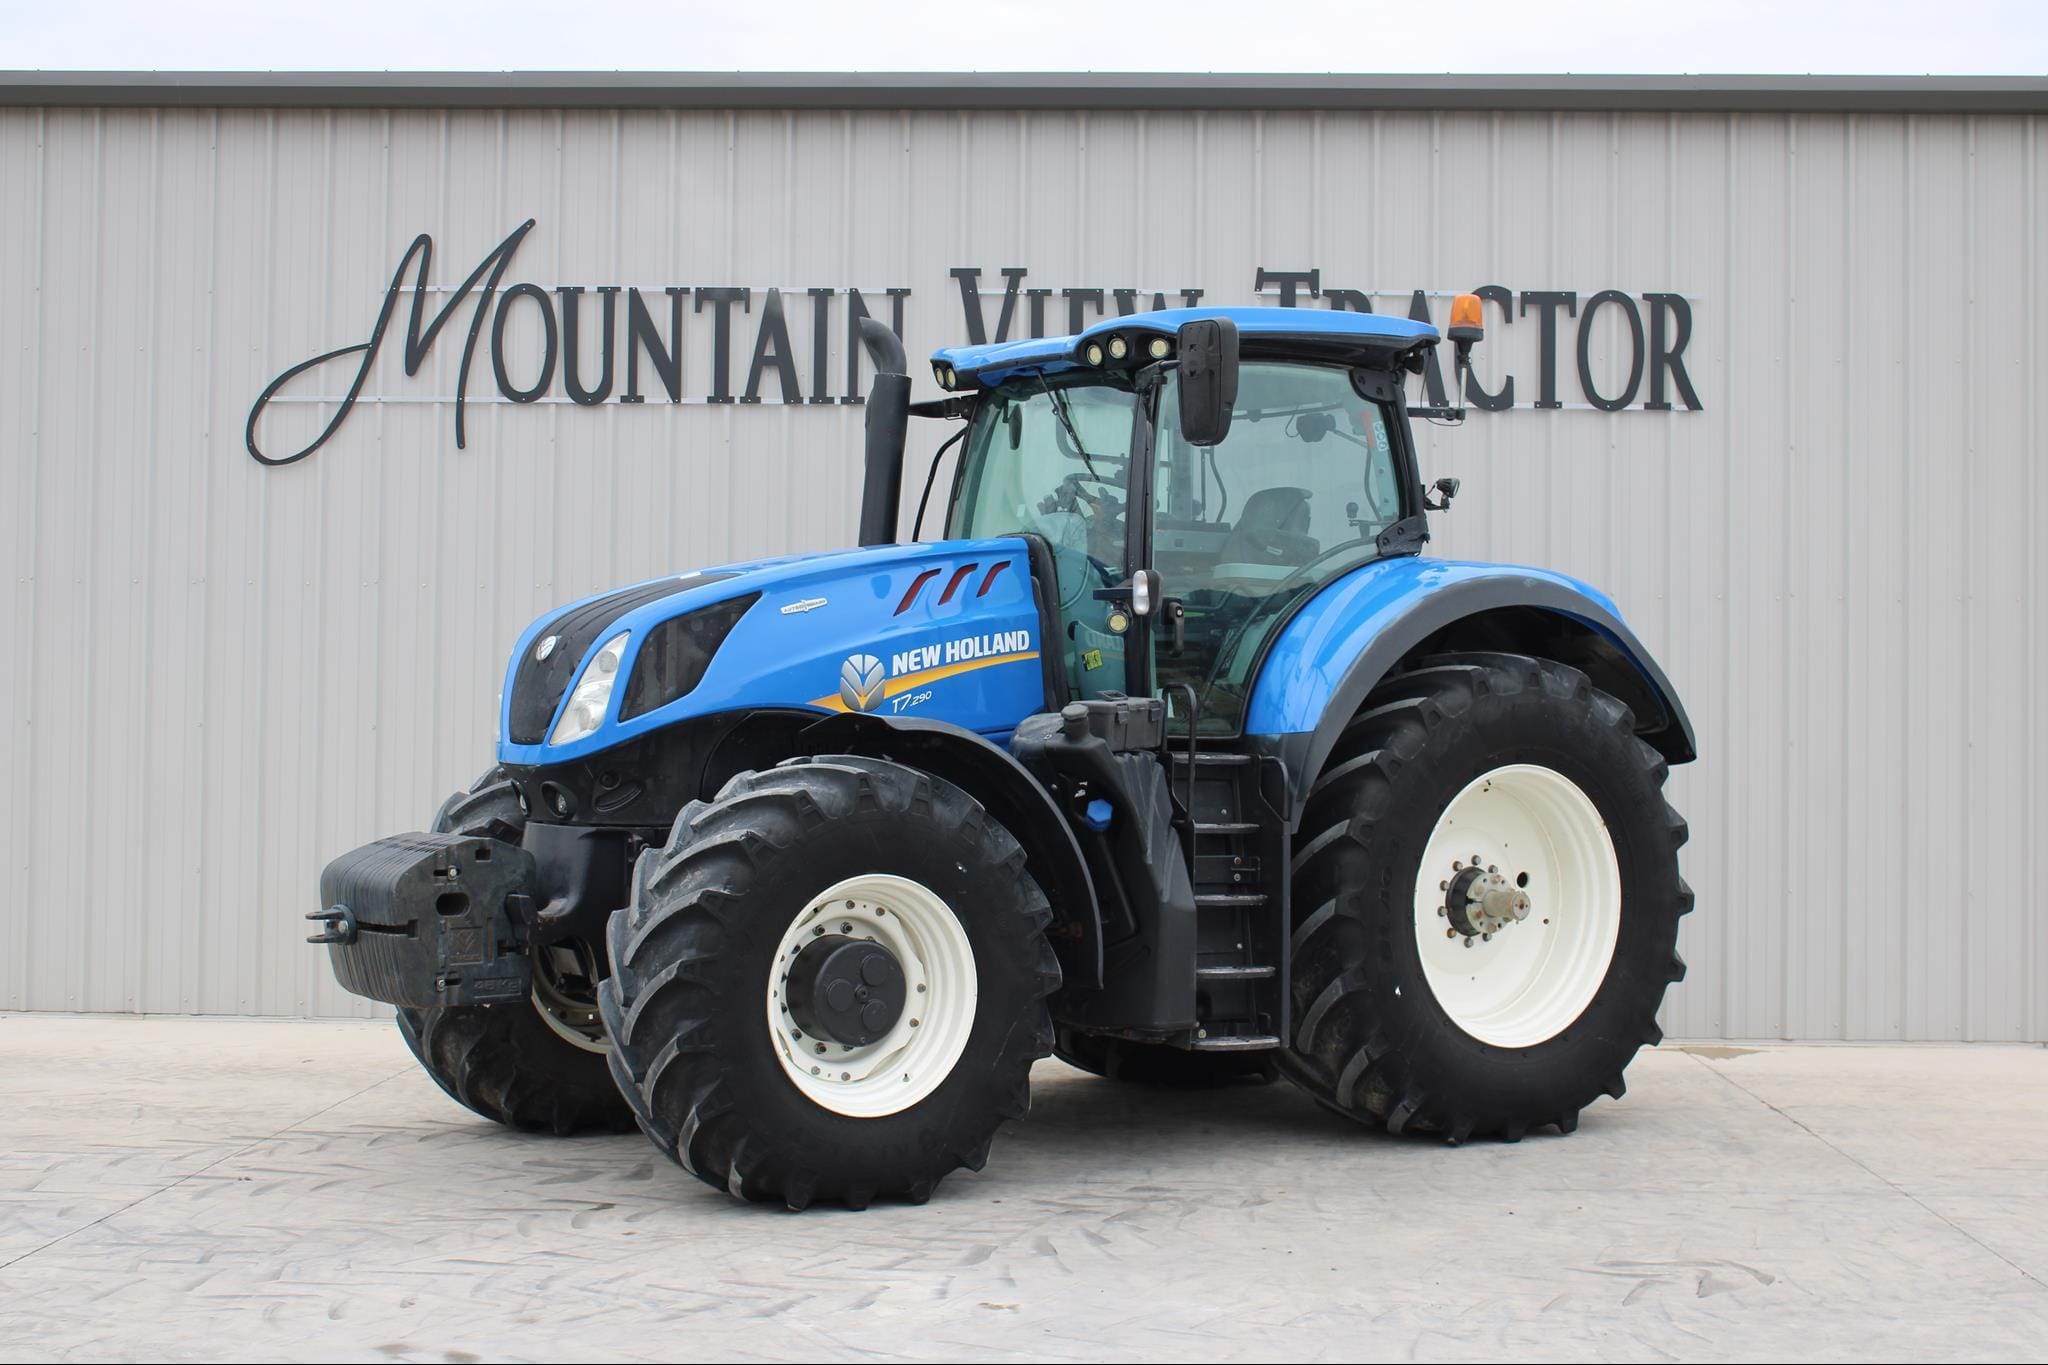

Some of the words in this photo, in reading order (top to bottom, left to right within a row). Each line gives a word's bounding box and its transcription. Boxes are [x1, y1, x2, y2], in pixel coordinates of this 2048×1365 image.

[1254, 267, 1704, 412] ACTOR
[892, 644, 942, 677] NEW
[945, 630, 1030, 663] HOLLAND
